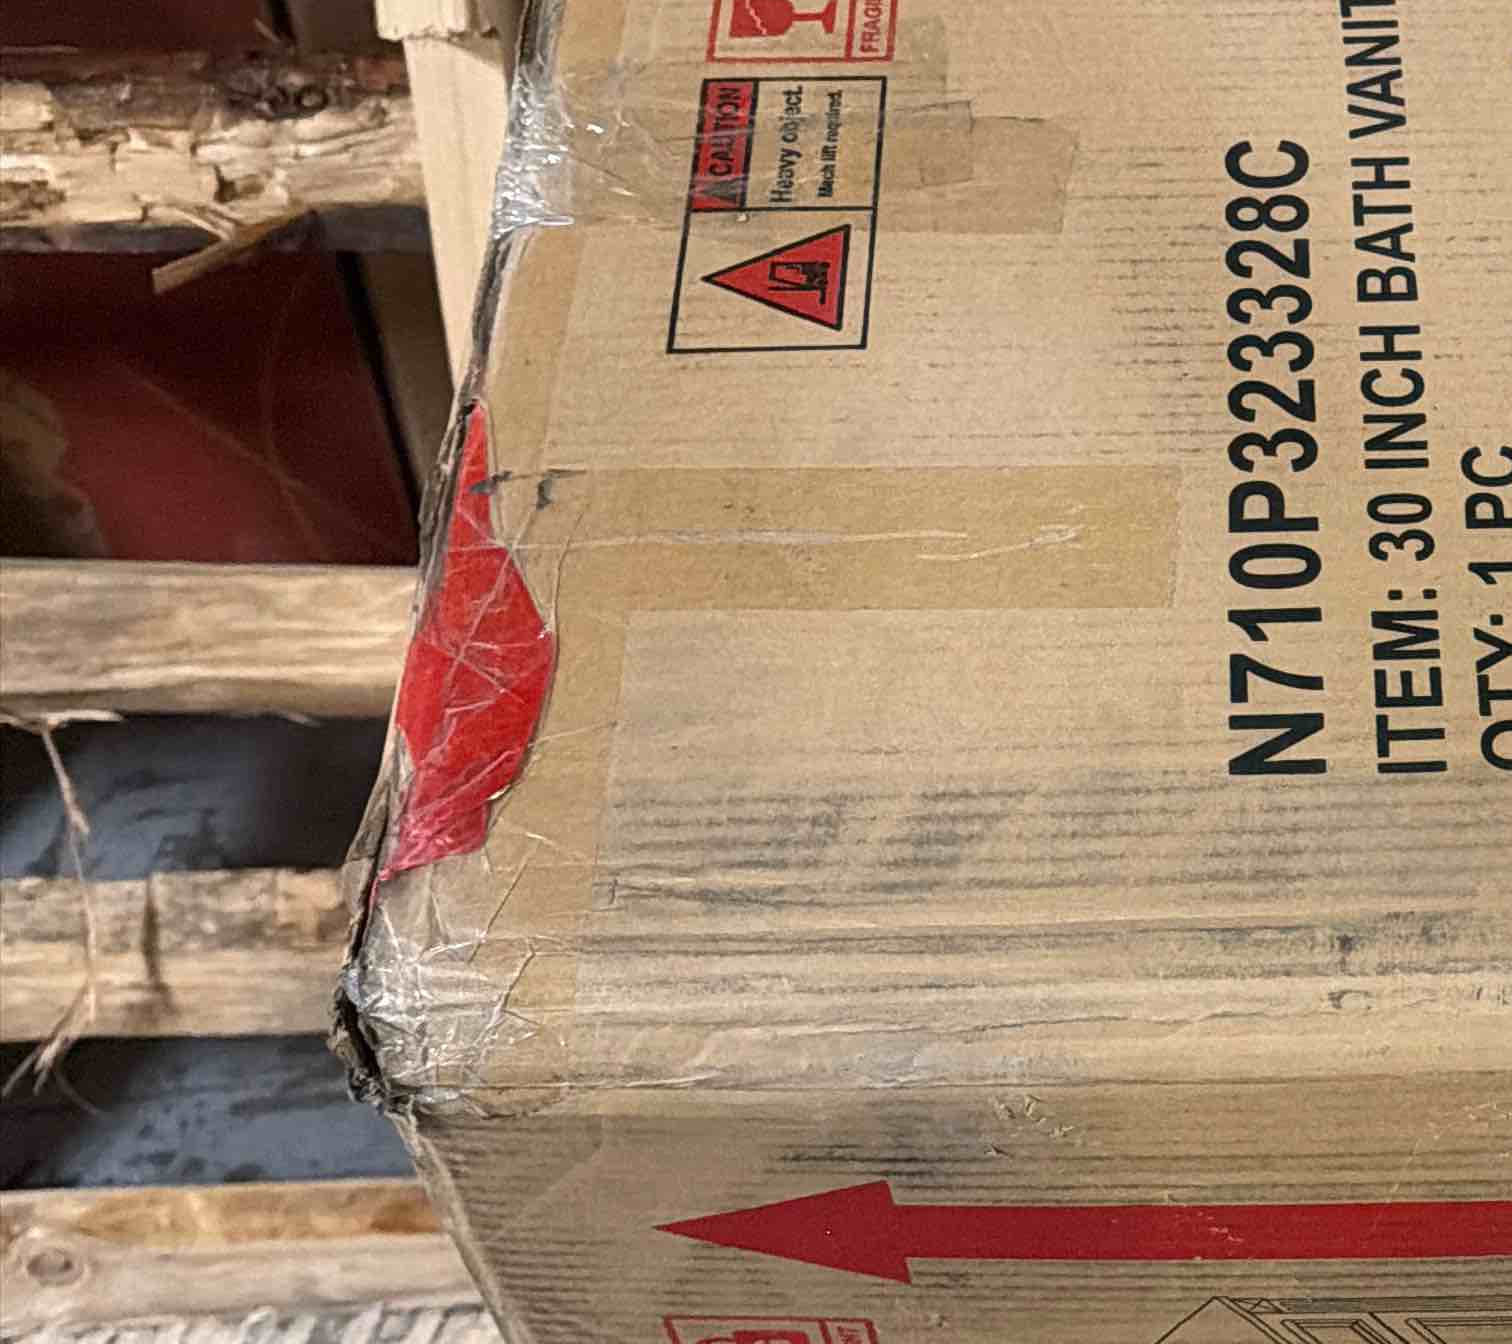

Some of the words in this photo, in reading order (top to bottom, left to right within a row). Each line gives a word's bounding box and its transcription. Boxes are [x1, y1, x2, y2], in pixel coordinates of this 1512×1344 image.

[708, 86, 741, 177] CAUTION
[781, 84, 804, 144] object.
[769, 147, 803, 204] Heavy
[1350, 156, 1418, 302] BATH
[1358, 324, 1430, 470] INCH
[1225, 139, 1327, 775] N710P323328C
[1366, 492, 1436, 562] 30
[1370, 587, 1448, 773] ITEM:
